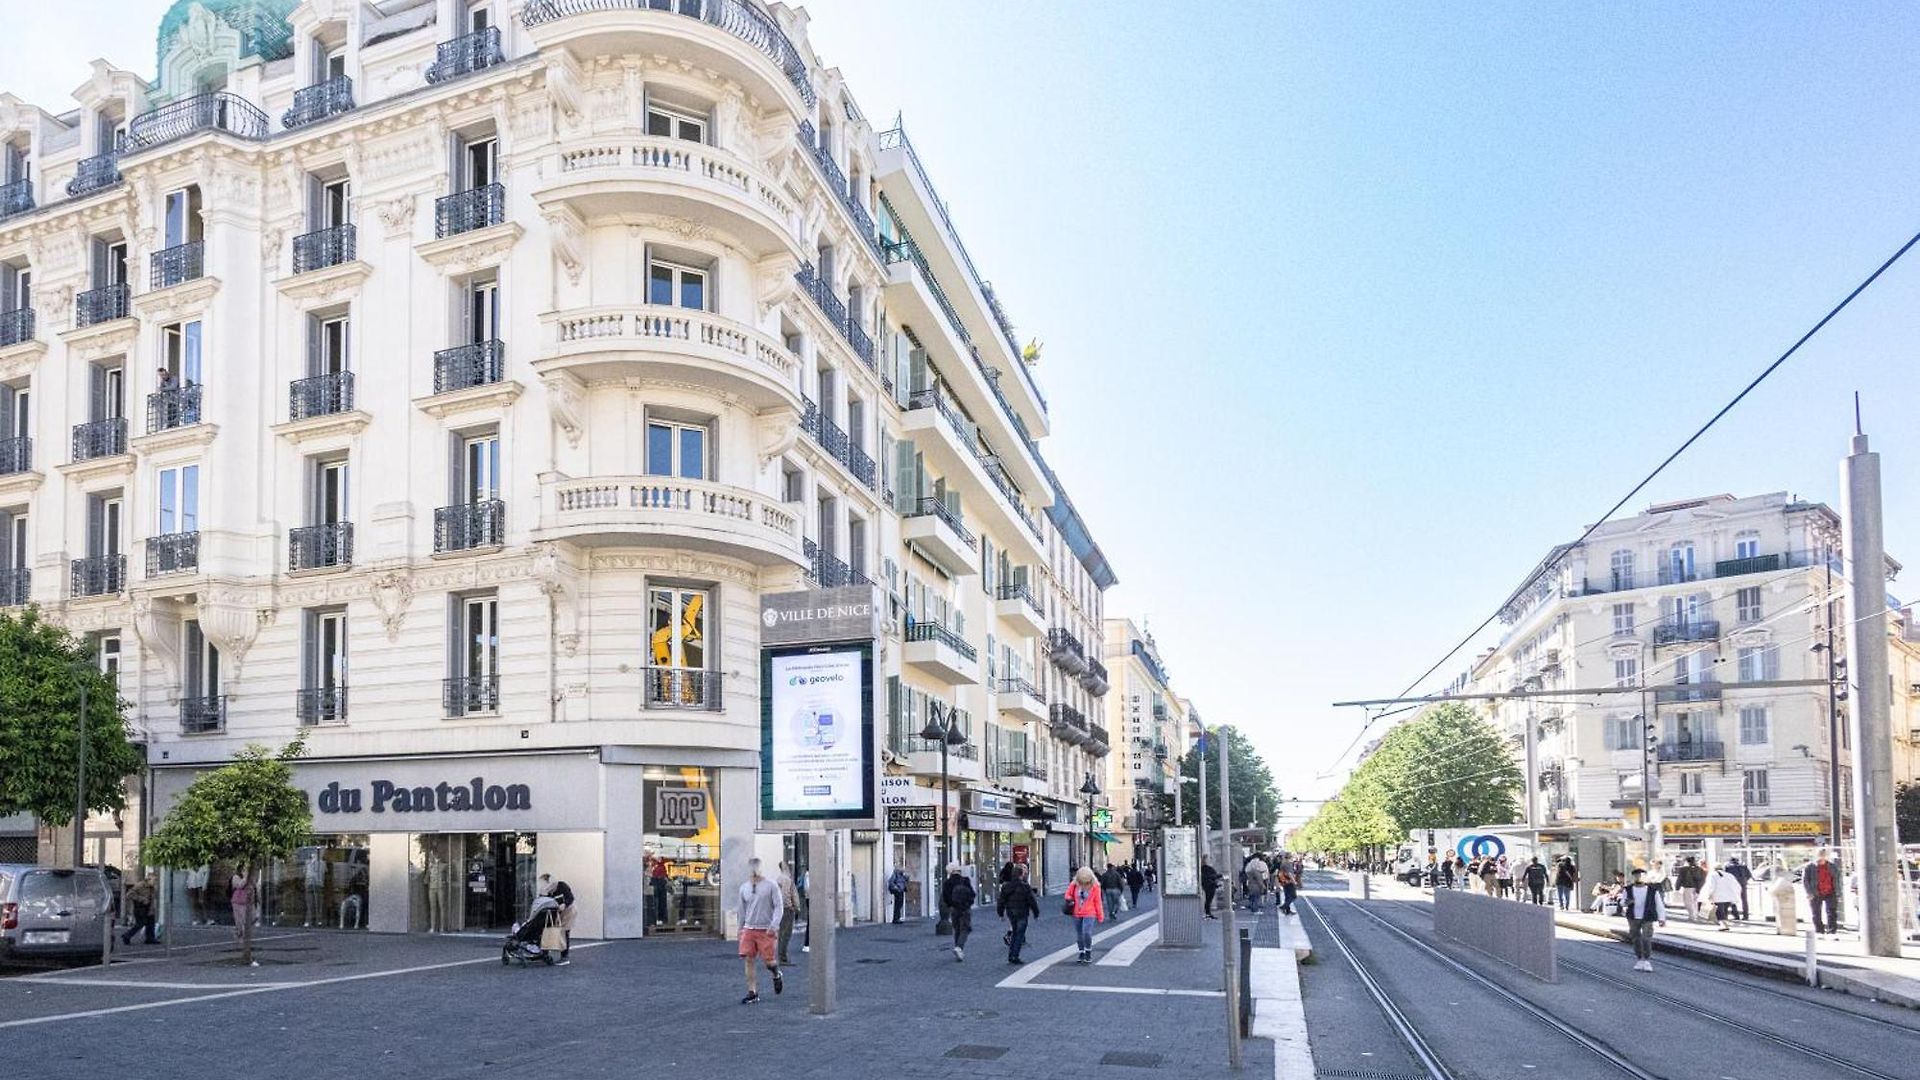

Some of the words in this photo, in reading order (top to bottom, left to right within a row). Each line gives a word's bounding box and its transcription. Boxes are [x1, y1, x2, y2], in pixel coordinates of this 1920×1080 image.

[780, 609, 814, 621] VILLE
[817, 607, 834, 619] DE
[837, 604, 870, 617] NICE
[809, 673, 844, 685] geovelo
[318, 781, 362, 814] du
[371, 776, 532, 813] Pantalon
[890, 810, 935, 820] CHANGE
[1673, 823, 1709, 833] FAST
